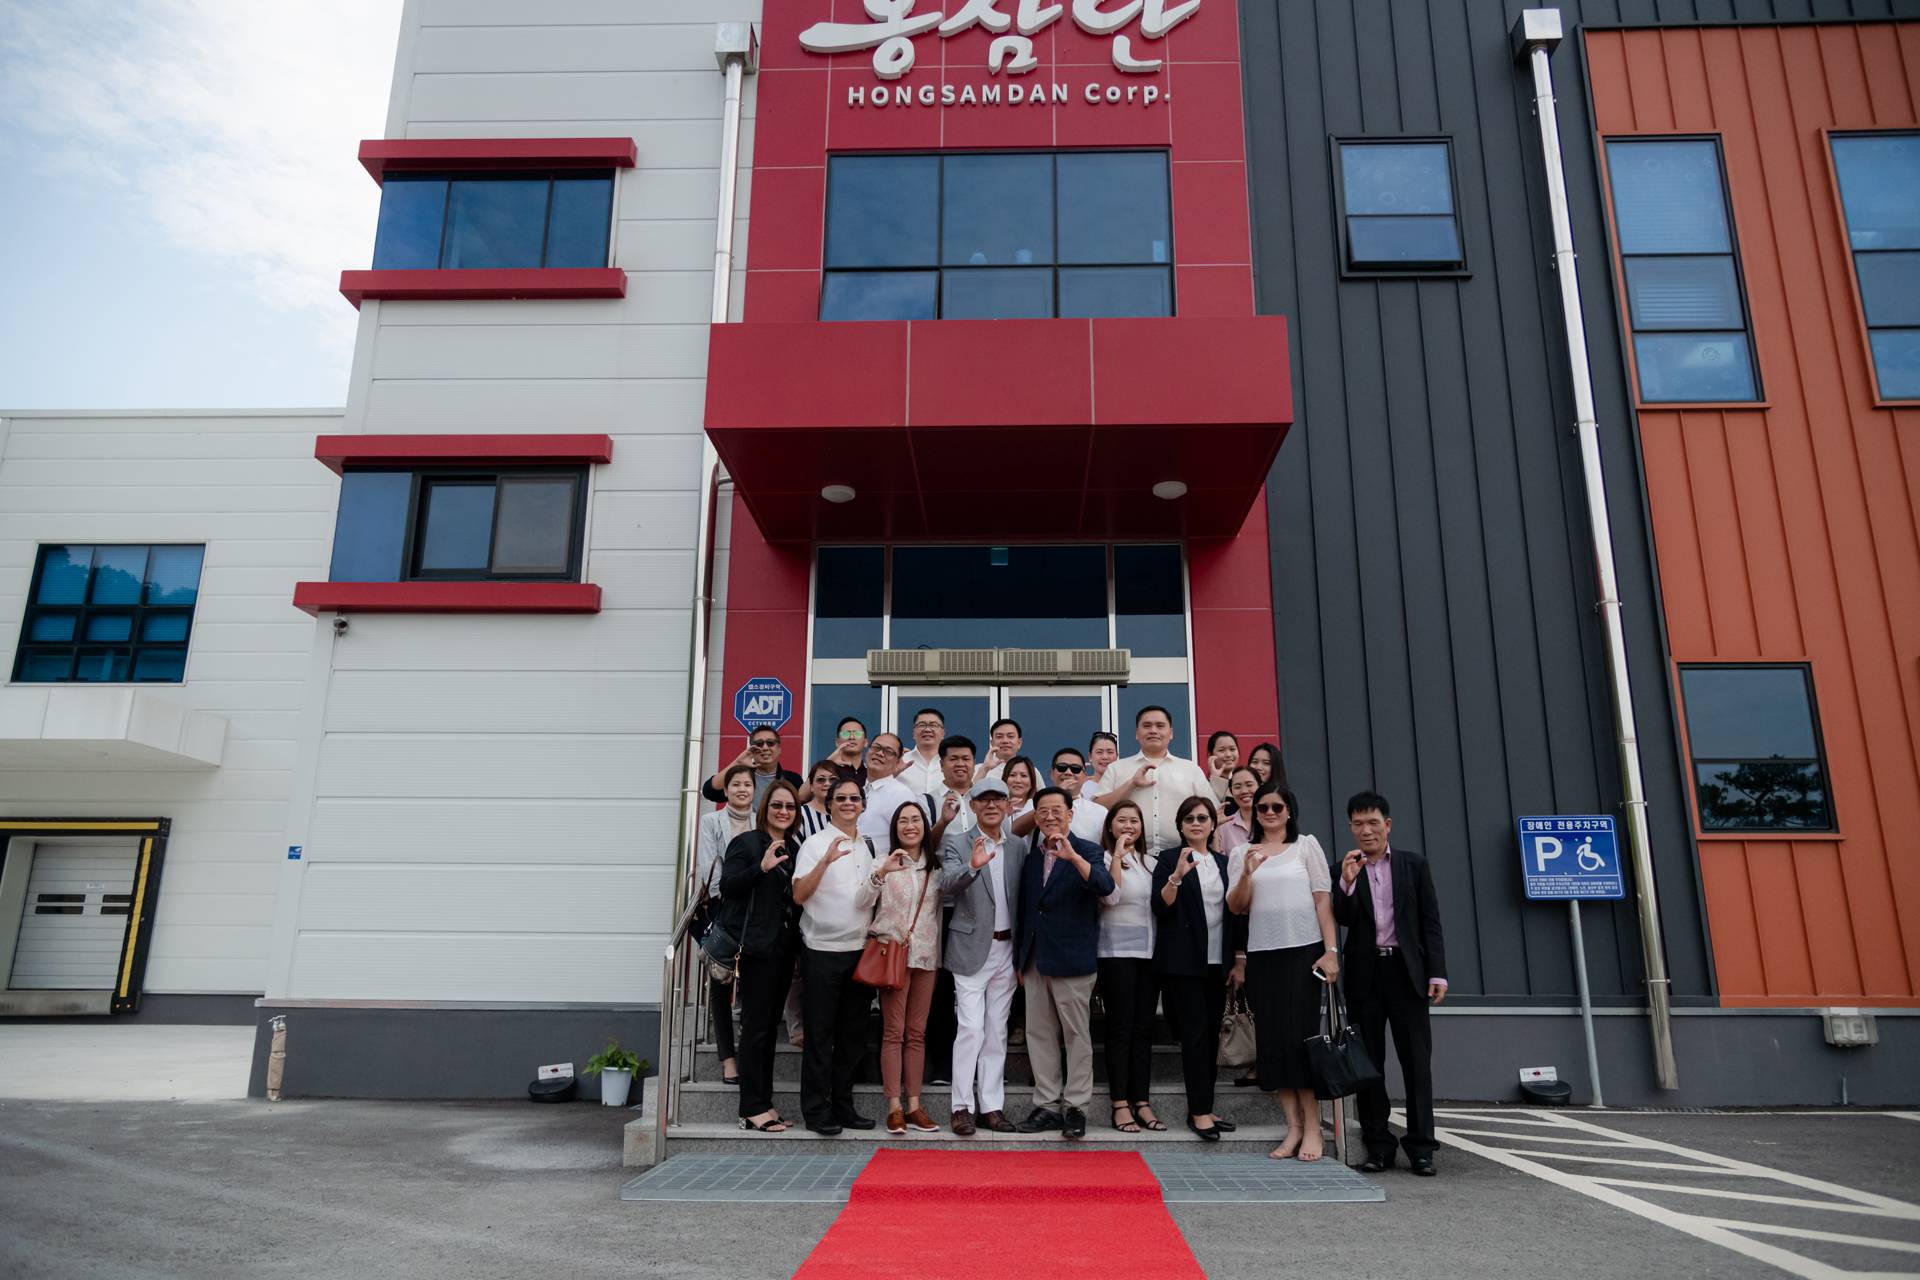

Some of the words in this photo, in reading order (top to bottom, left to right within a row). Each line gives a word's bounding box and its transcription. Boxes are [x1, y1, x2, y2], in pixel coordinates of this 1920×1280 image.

[848, 83, 1068, 107] HONGSAMDAN
[1085, 82, 1171, 107] Corp.
[744, 696, 782, 714] ADT
[1527, 821, 1552, 830] 장애인
[1557, 821, 1608, 830] 전용주차구역
[1535, 836, 1562, 872] P
